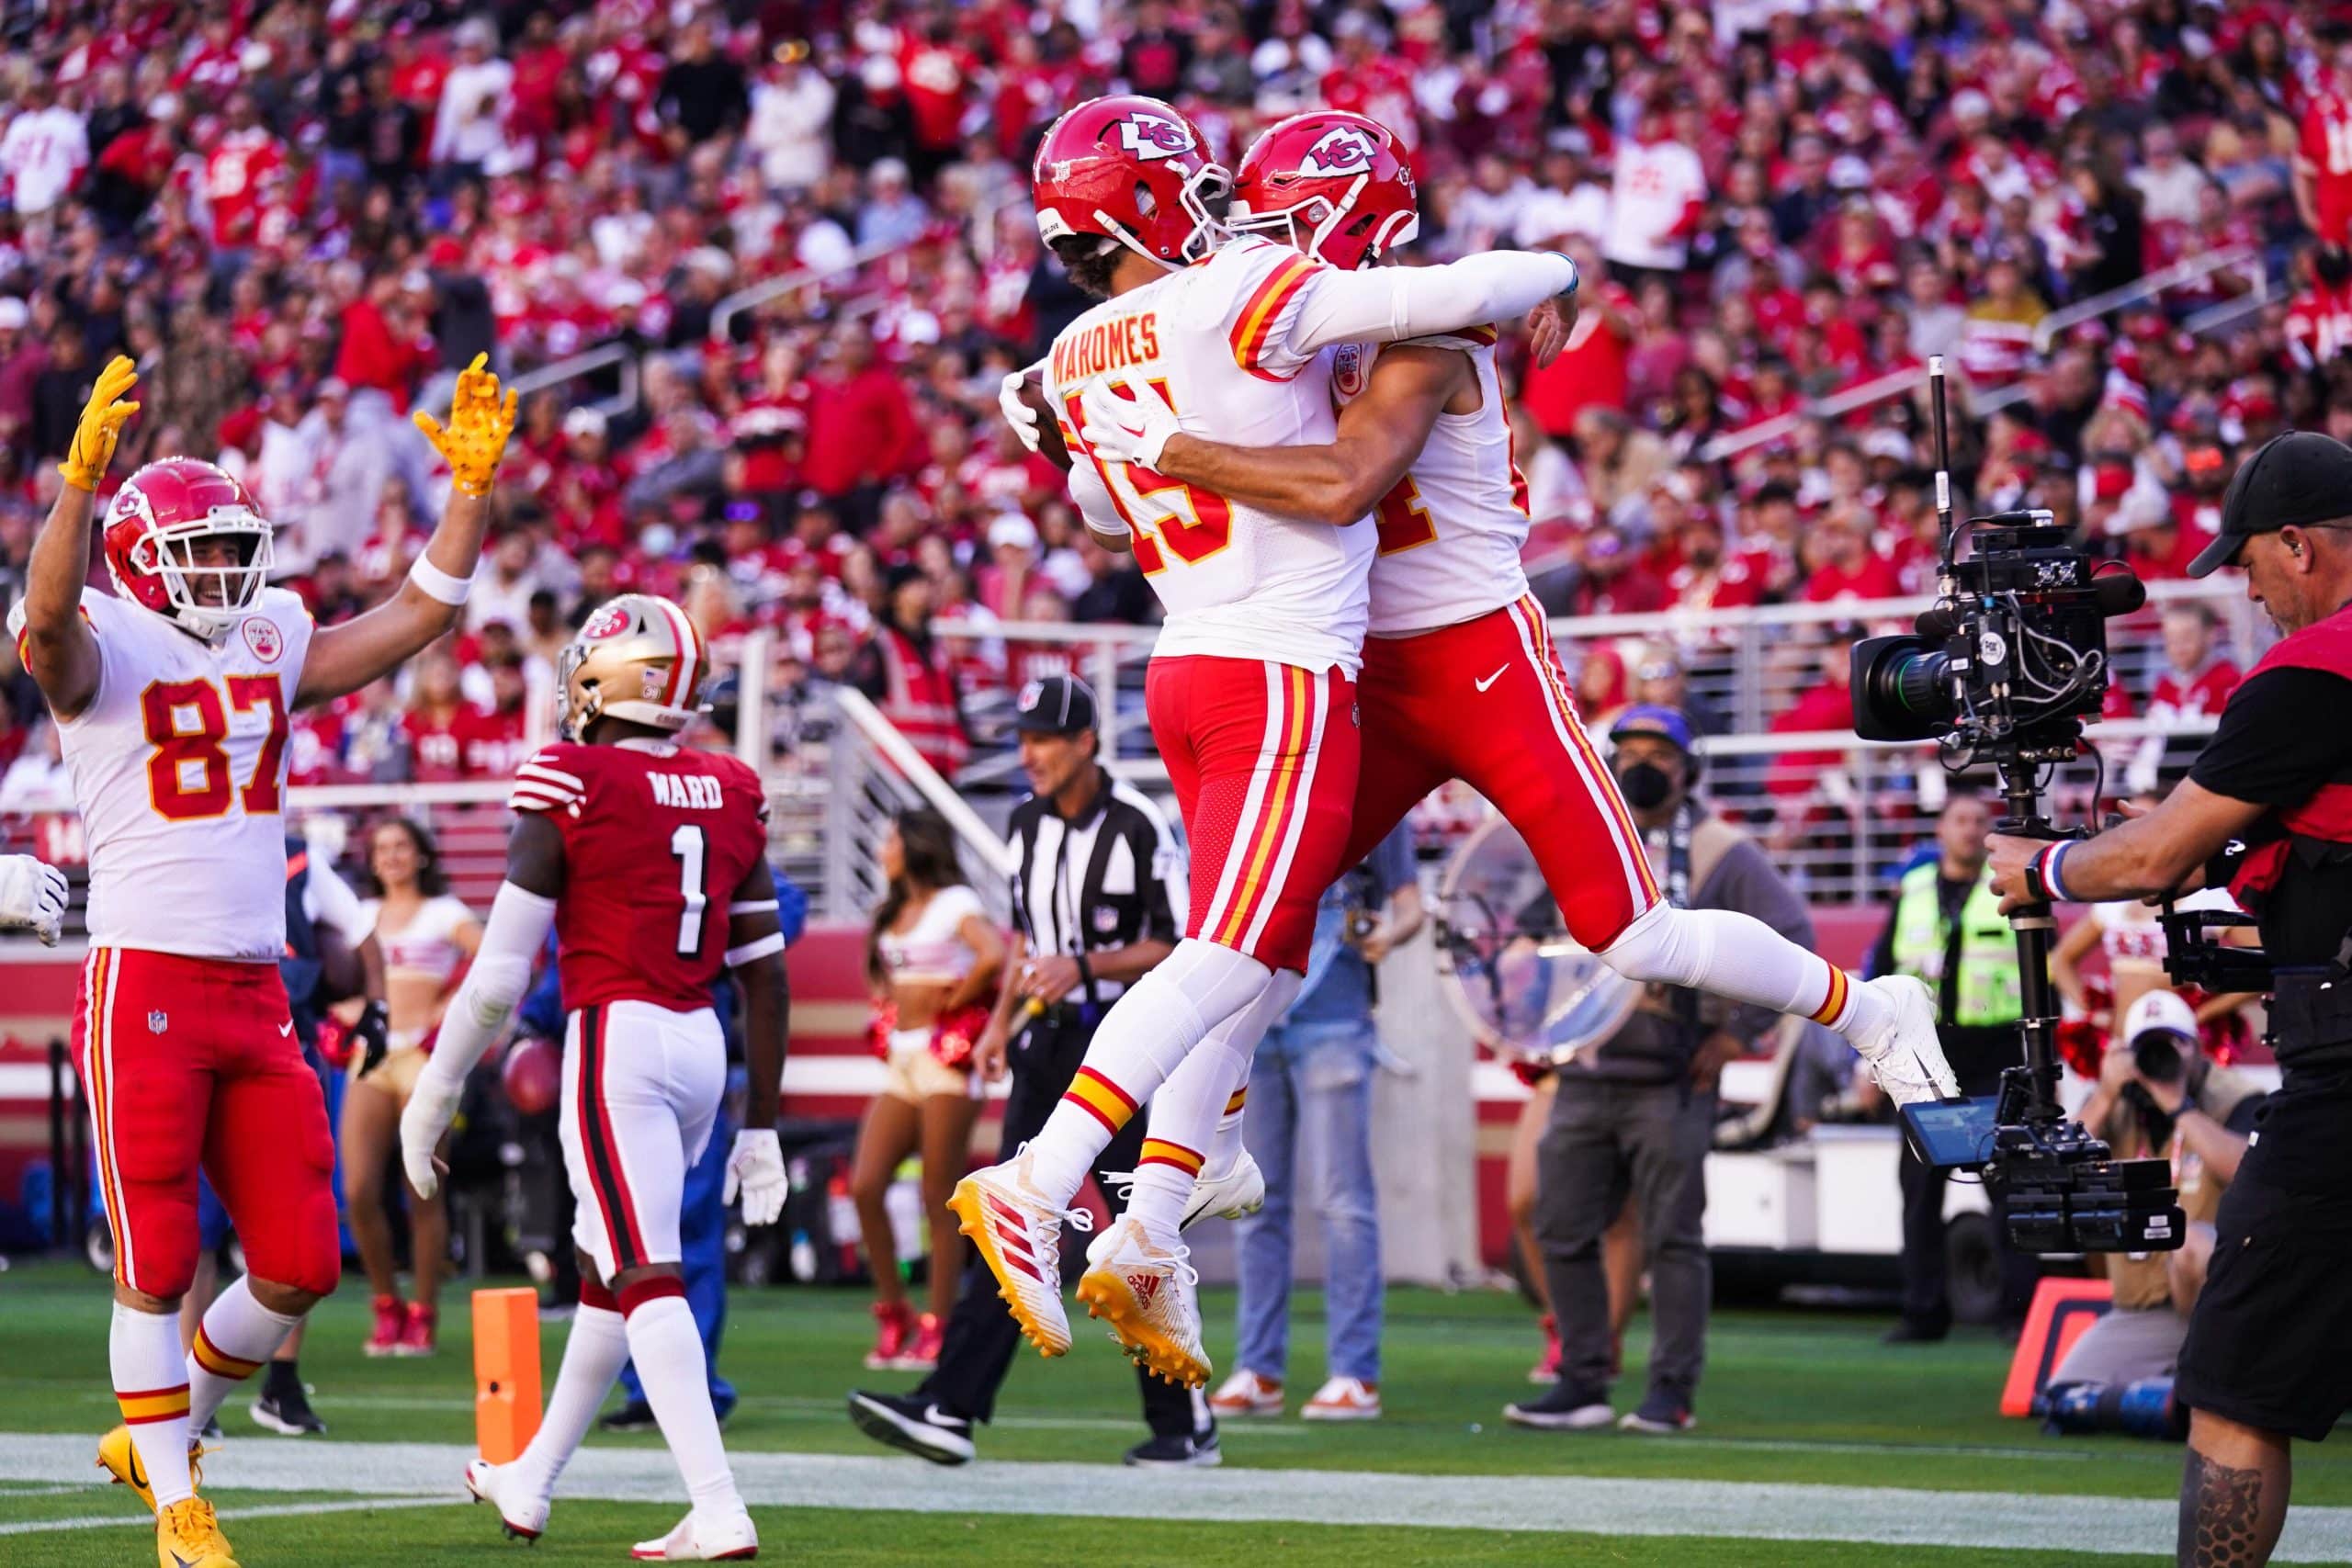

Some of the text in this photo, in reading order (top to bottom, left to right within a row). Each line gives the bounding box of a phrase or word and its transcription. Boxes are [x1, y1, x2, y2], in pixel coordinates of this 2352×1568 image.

[1053, 310, 1160, 386] MAHOMES
[1064, 377, 1235, 579] 15
[140, 672, 289, 823] 87
[646, 771, 724, 809] WARD
[671, 824, 710, 961] 1
[1127, 1275, 1151, 1310] adidas
